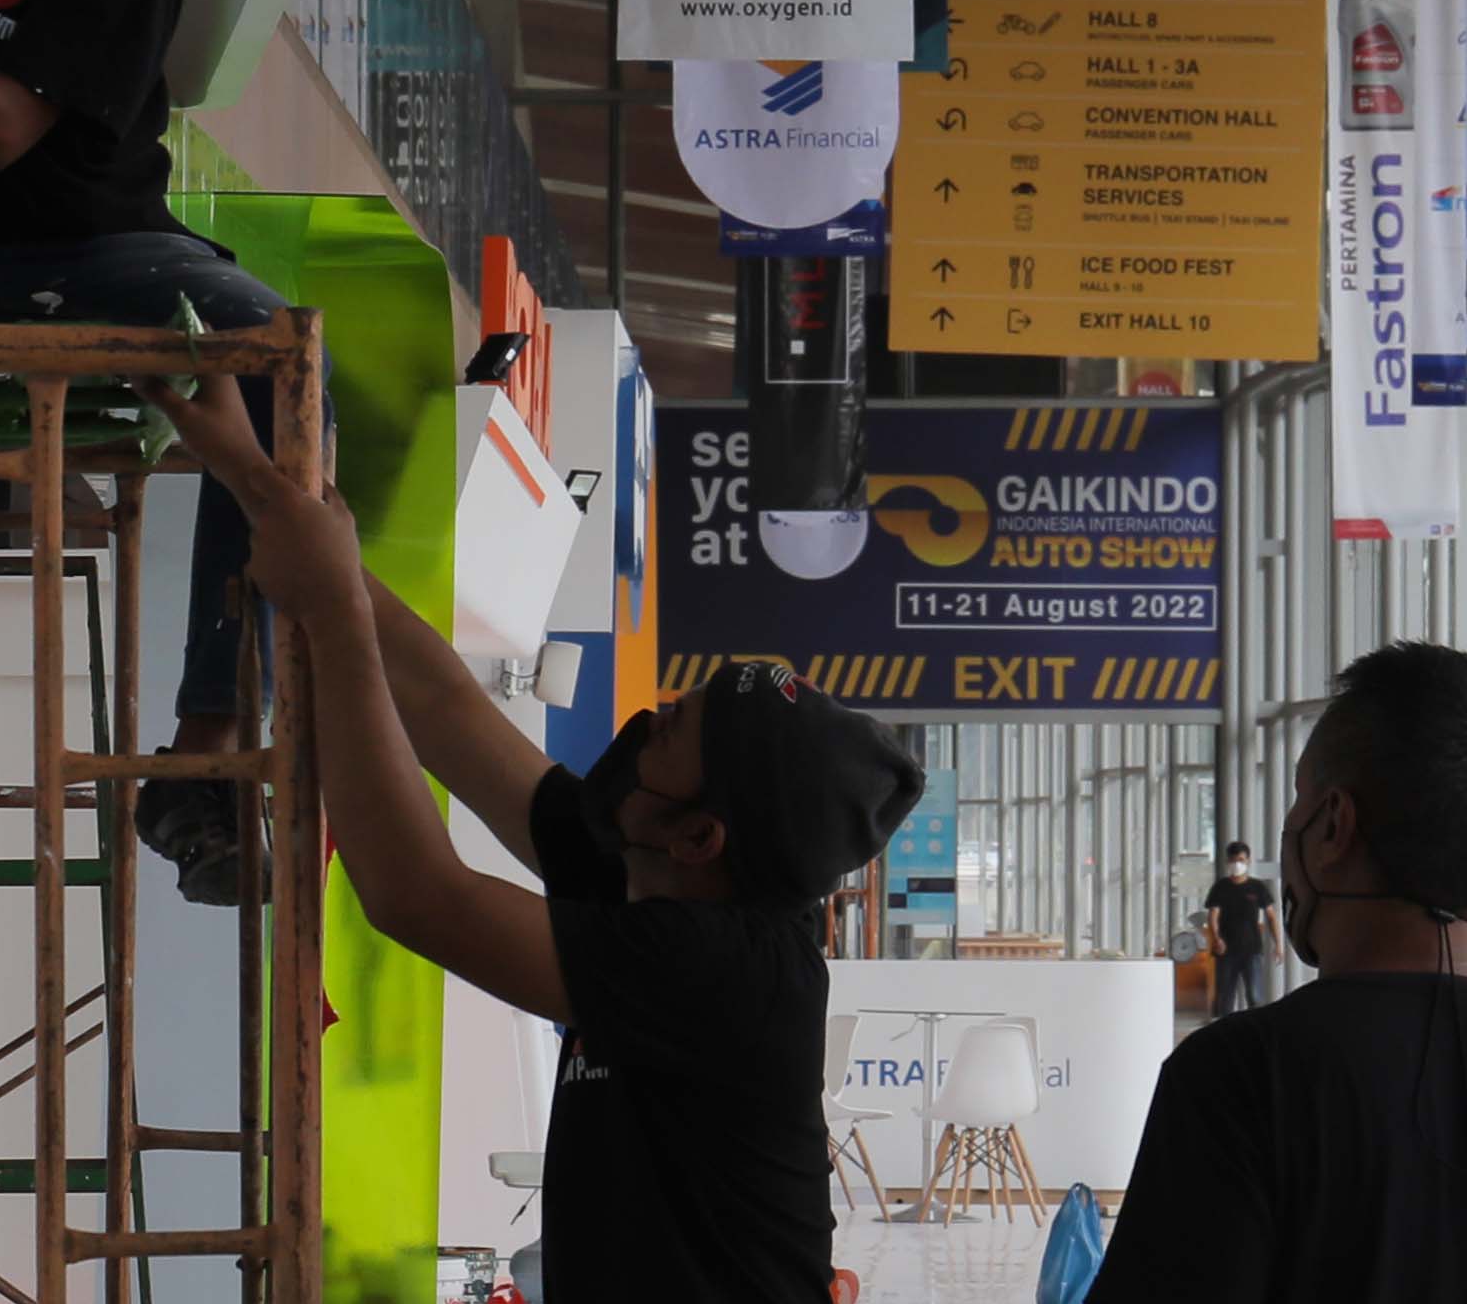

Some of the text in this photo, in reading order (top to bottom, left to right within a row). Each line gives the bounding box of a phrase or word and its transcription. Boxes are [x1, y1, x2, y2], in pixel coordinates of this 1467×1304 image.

[1088, 11, 1158, 28] HALL 8
[1087, 57, 1140, 74] HALL
[1147, 59, 1155, 74] 1
[1174, 58, 1199, 75] 3A
[1086, 78, 1157, 89] PASSENGER
[1085, 106, 1277, 127] CONVENTION HALL
[695, 127, 880, 149] ASTRA Financial
[1085, 129, 1155, 140] PASSENGER
[1084, 164, 1268, 183] TRANSPORTATION
[1083, 189, 1184, 206] SERVICES
[1340, 155, 1357, 291] PERTAMINA
[1081, 256, 1234, 276] ICE FOOD FEST
[1080, 282, 1110, 292] HALL
[1365, 153, 1406, 427] Fastron
[1080, 313, 1210, 331] EXIT HALL 10
[691, 431, 749, 468] se
[997, 476, 1217, 514] GAIKINDO
[997, 517, 1216, 534] INDONESIA INTERNATIONAL
[690, 522, 749, 566] at
[990, 537, 1215, 569] AUTO SHOW
[908, 594, 1206, 622] 11-21 August 2022
[955, 657, 1076, 700] EXIT
[846, 1059, 924, 1087] TRA
